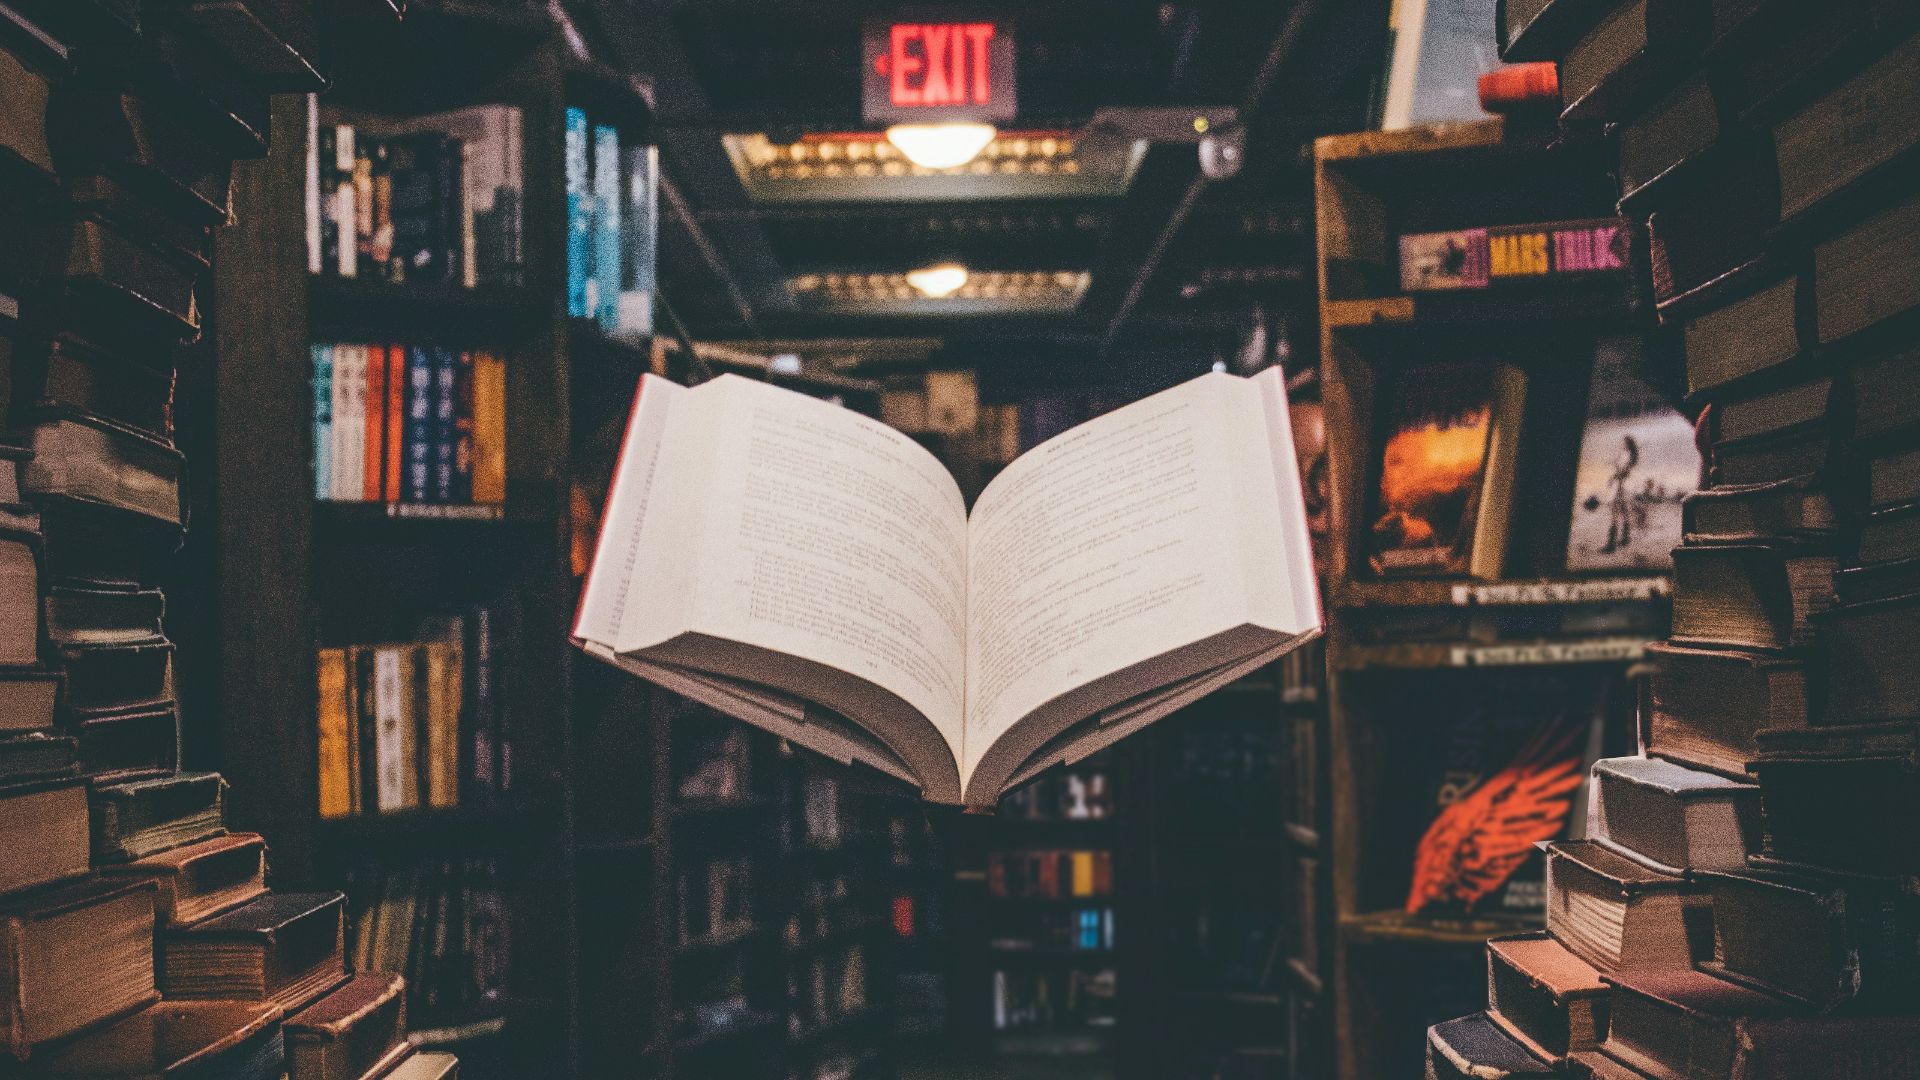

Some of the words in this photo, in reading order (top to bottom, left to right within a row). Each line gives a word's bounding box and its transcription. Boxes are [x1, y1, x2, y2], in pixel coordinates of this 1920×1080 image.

[891, 24, 994, 105] EXIT
[1489, 233, 1548, 274] MARS
[1561, 645, 1630, 661] Fantasy
